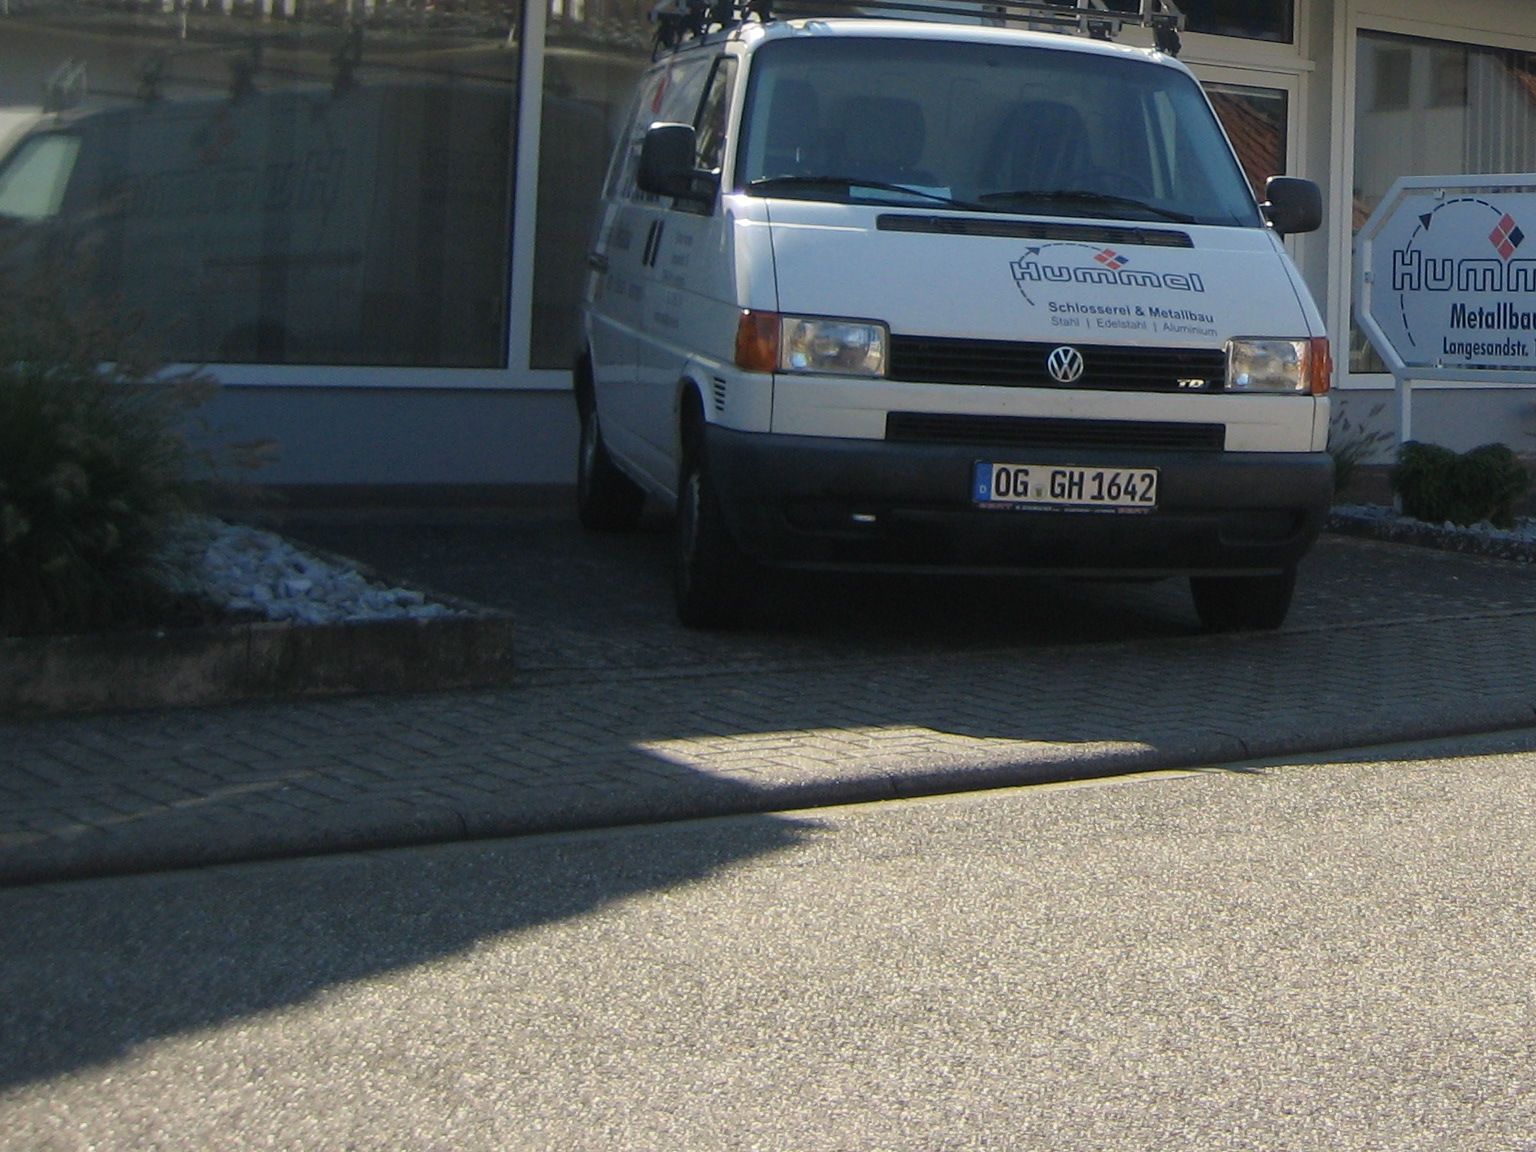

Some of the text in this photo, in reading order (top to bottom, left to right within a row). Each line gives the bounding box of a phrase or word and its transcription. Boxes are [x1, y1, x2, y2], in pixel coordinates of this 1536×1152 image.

[1009, 261, 1205, 293] Hummel
[1048, 301, 1214, 324] Schlosserei & Metallbau
[1051, 316, 1219, 338] Stahl Edelstahl Aluminium
[1443, 336, 1529, 360] Langesandstr.
[995, 467, 1029, 497] OG
[1051, 470, 1084, 499] GH
[1090, 471, 1155, 503] 1642
